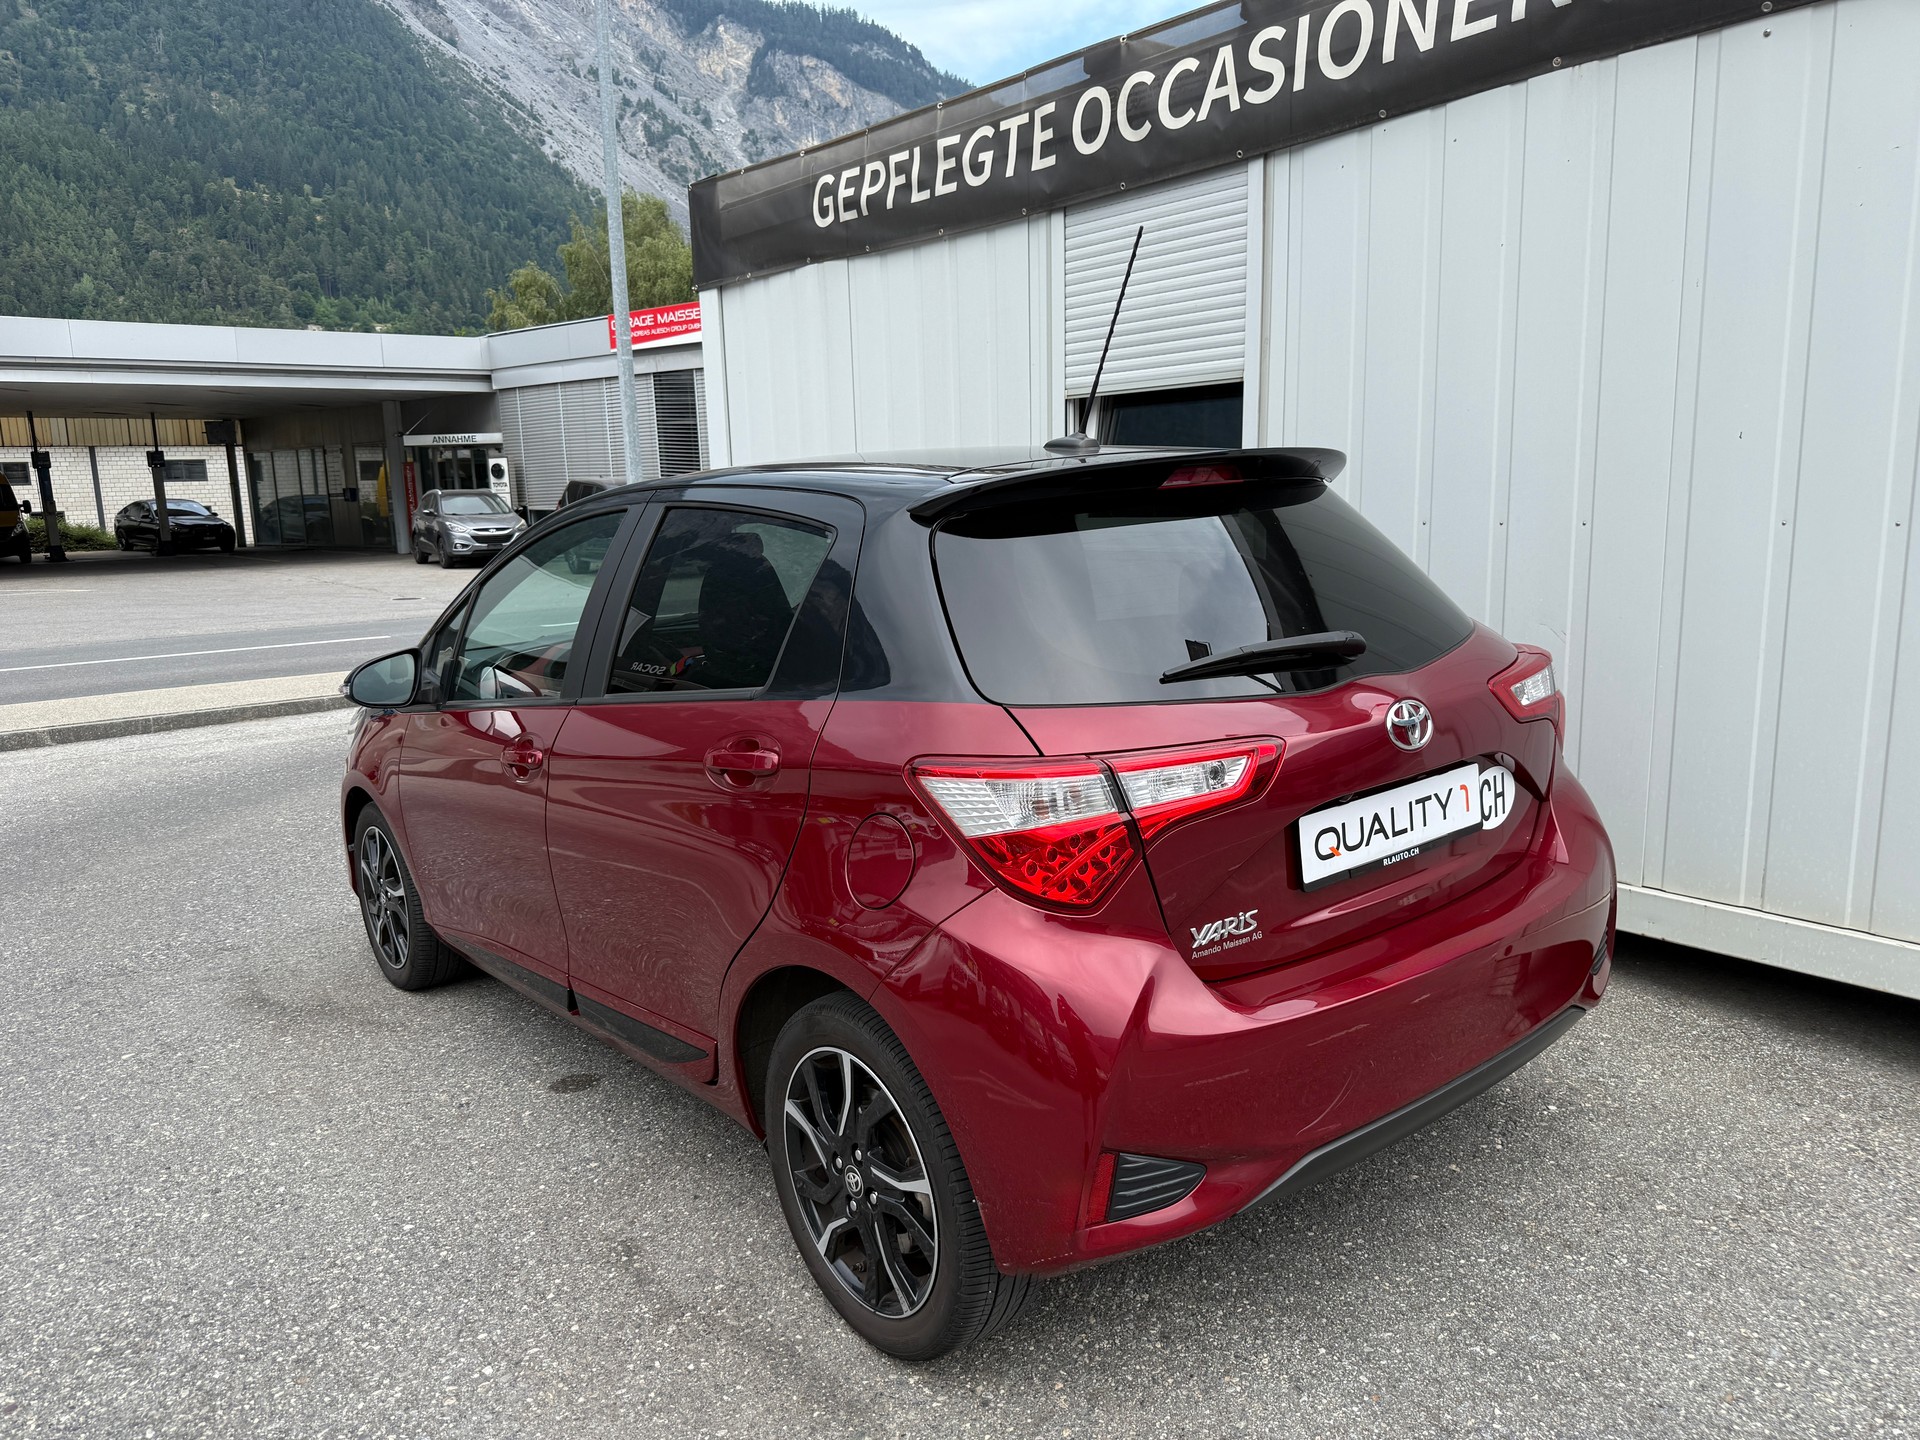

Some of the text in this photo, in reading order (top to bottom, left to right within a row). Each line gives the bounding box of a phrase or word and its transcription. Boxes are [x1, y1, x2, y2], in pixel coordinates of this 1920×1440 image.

[813, 0, 1572, 228] GEPFLEGTE OCCASIONE
[611, 307, 701, 330] GRAGE MAISSE
[432, 435, 477, 444] ANNAHME
[1480, 772, 1506, 822] CH
[1314, 784, 1470, 861] QUALITY 1
[1383, 847, 1420, 867] RLAUTO.CH
[1191, 931, 1263, 960] Amando Maissen AG
